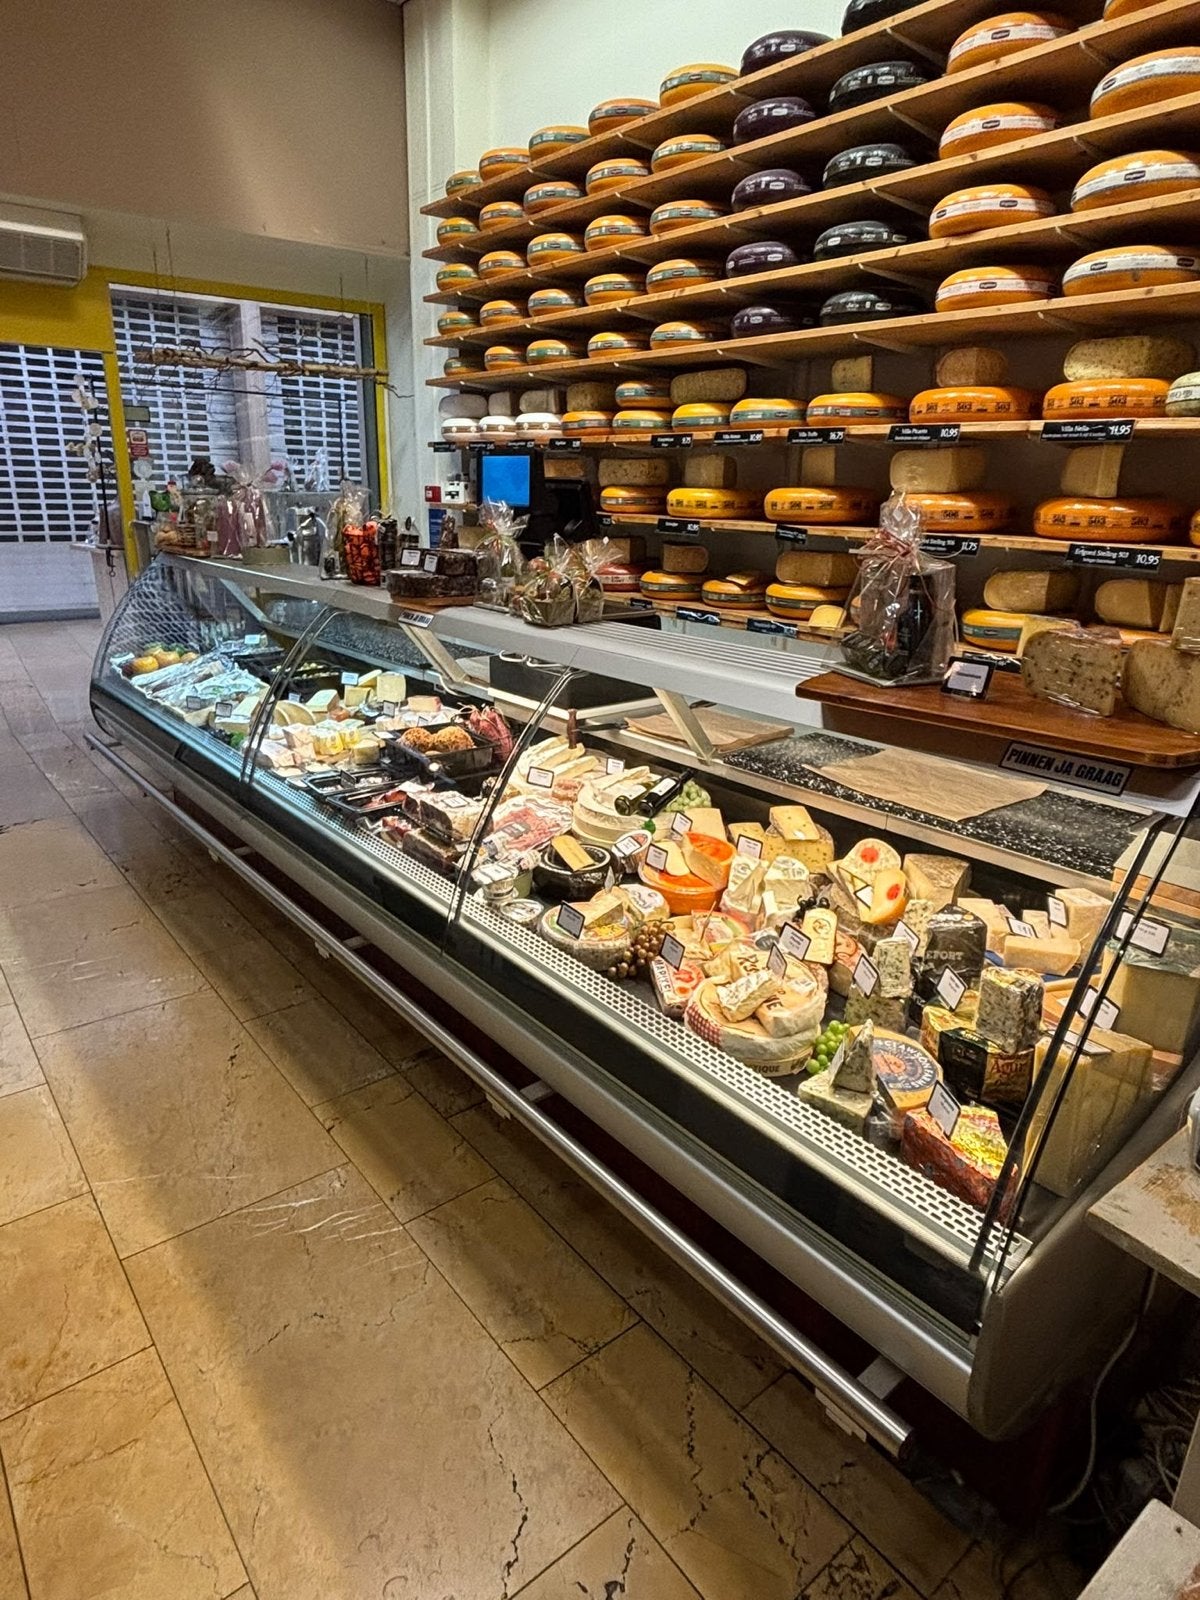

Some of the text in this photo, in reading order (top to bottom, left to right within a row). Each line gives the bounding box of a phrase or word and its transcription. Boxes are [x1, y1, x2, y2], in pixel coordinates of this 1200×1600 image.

[1136, 554, 1160, 565] 10.95
[1006, 748, 1124, 787] PINNEN JA GRAAG
